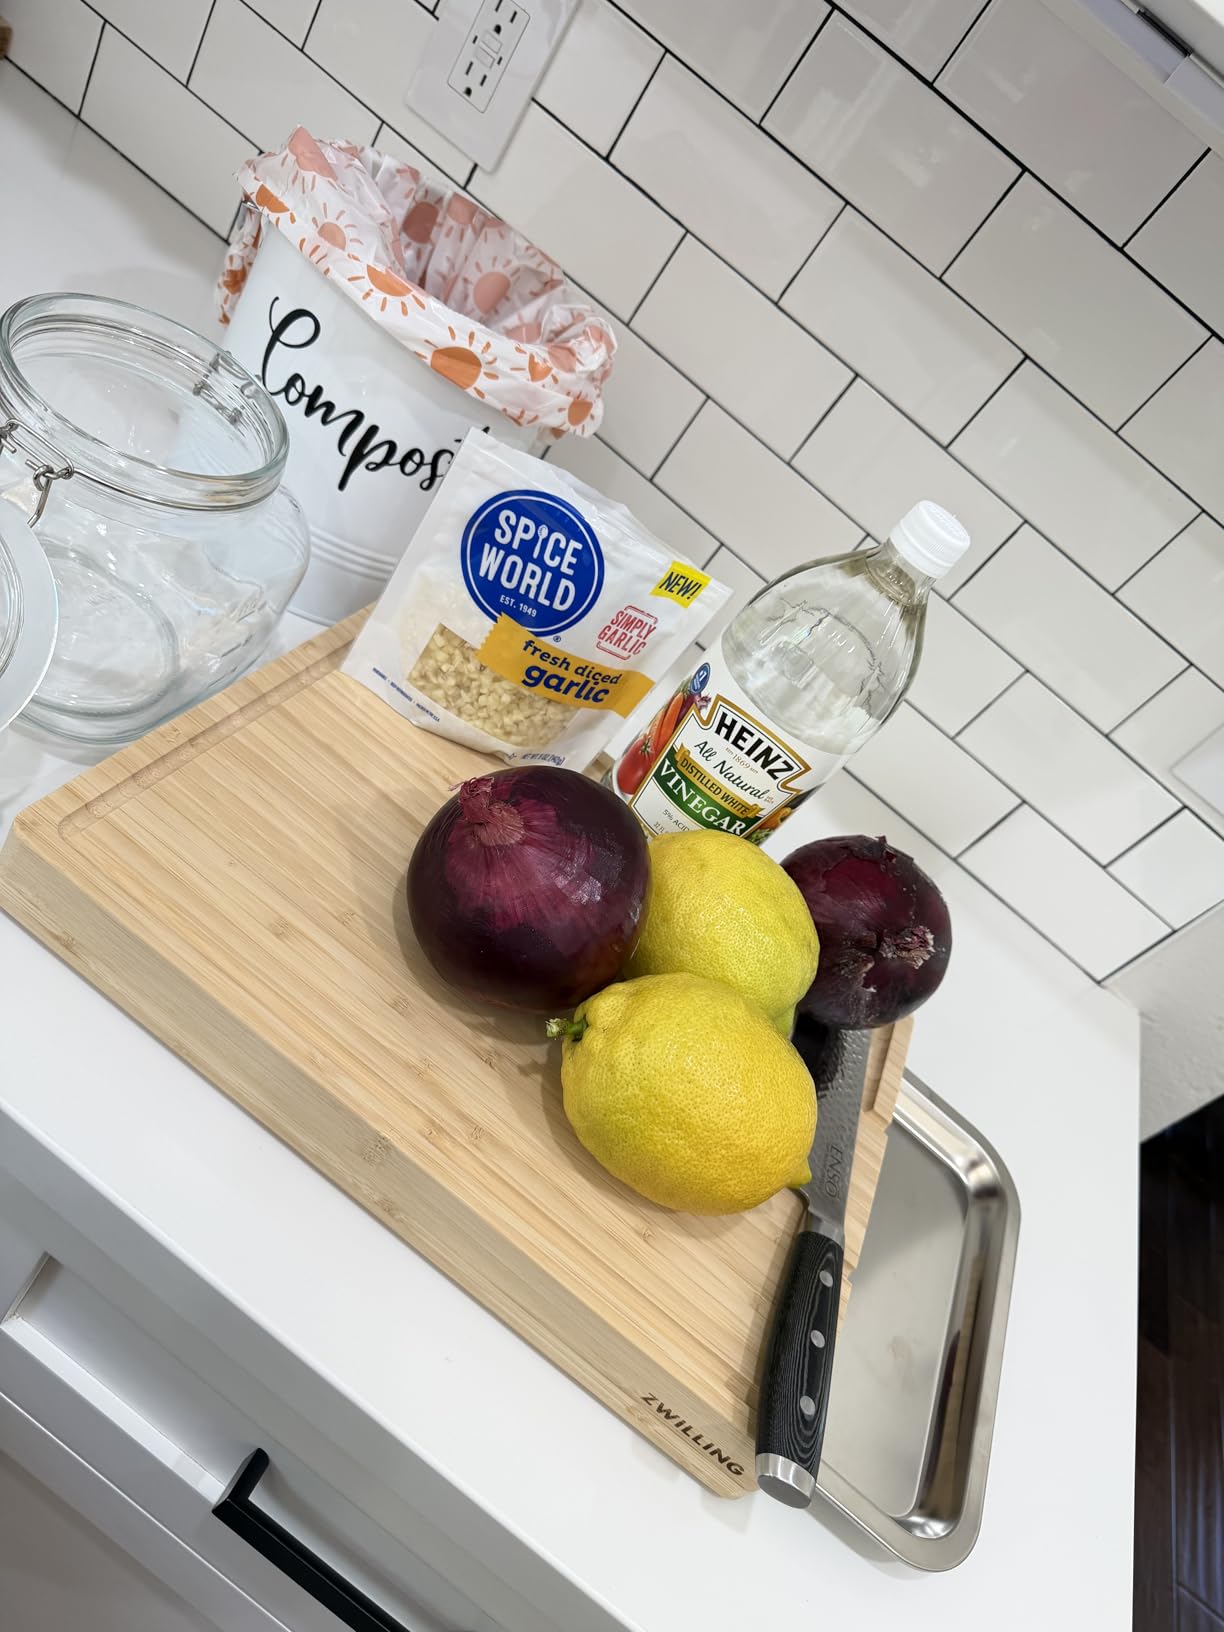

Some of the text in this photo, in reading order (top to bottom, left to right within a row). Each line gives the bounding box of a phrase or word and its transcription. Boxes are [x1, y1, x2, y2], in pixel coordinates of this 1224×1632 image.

[262, 297, 490, 492] Compos
[494, 509, 583, 576] SPICE
[479, 543, 576, 612] WORLD
[500, 594, 537, 618] EST. 1949
[659, 571, 702, 600] NEW!
[598, 625, 647, 655] GARLIC
[610, 610, 657, 641] SIMPLY
[521, 664, 610, 703] garlic
[523, 640, 622, 685] fresh diced
[694, 740, 770, 800] All Natural
[714, 711, 794, 781] HEINZ
[660, 758, 746, 836] VINEGAR
[680, 757, 750, 816] DISTILLED WHITE
[640, 1392, 745, 1476] ZWILLING
